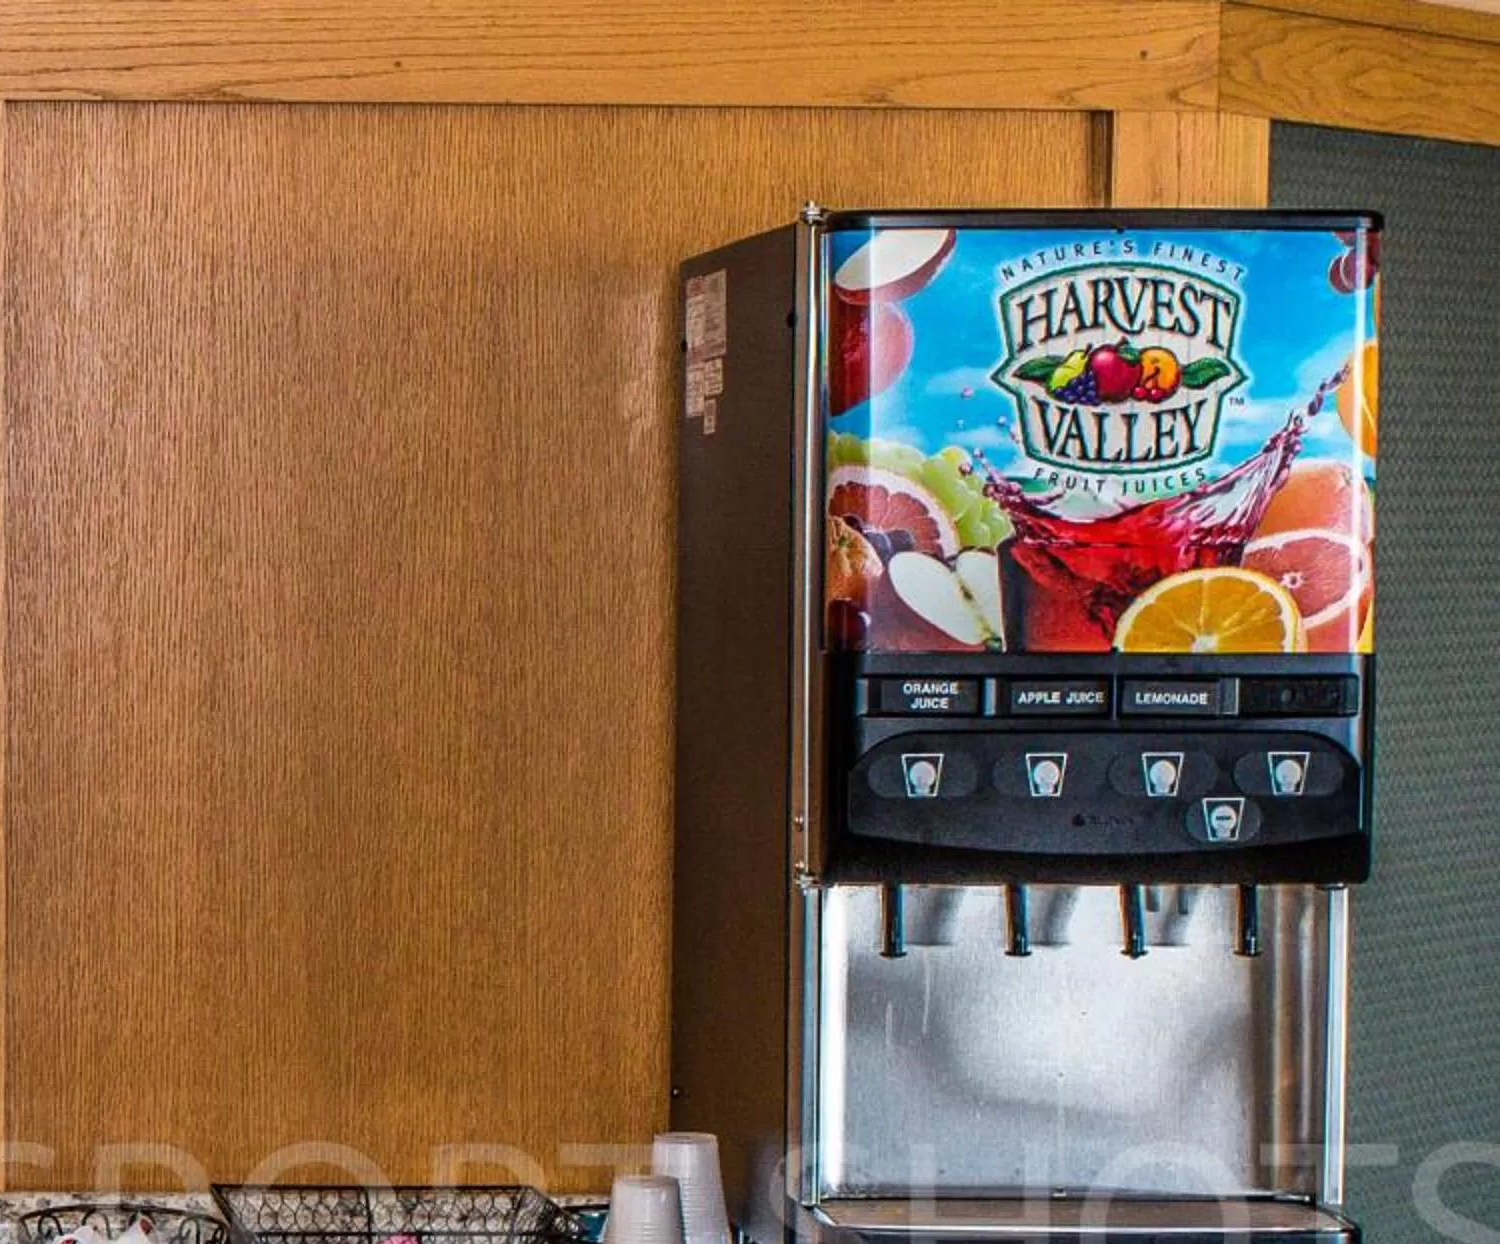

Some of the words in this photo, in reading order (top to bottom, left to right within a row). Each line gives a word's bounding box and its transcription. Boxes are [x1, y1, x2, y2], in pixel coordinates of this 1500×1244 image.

[1001, 239, 1134, 281] NATURE'S
[1153, 241, 1246, 281] FINEST
[1015, 277, 1231, 351] HARVEST
[1031, 395, 1209, 463] VALLEY
[1033, 467, 1106, 493] FRUIT
[1122, 467, 1206, 496] JUICES
[902, 682, 959, 695] ORANGE
[1017, 691, 1061, 705] APPLE
[1066, 691, 1105, 704] JUICE
[1135, 691, 1208, 705] LEMONADE
[910, 697, 949, 709] JUICE
